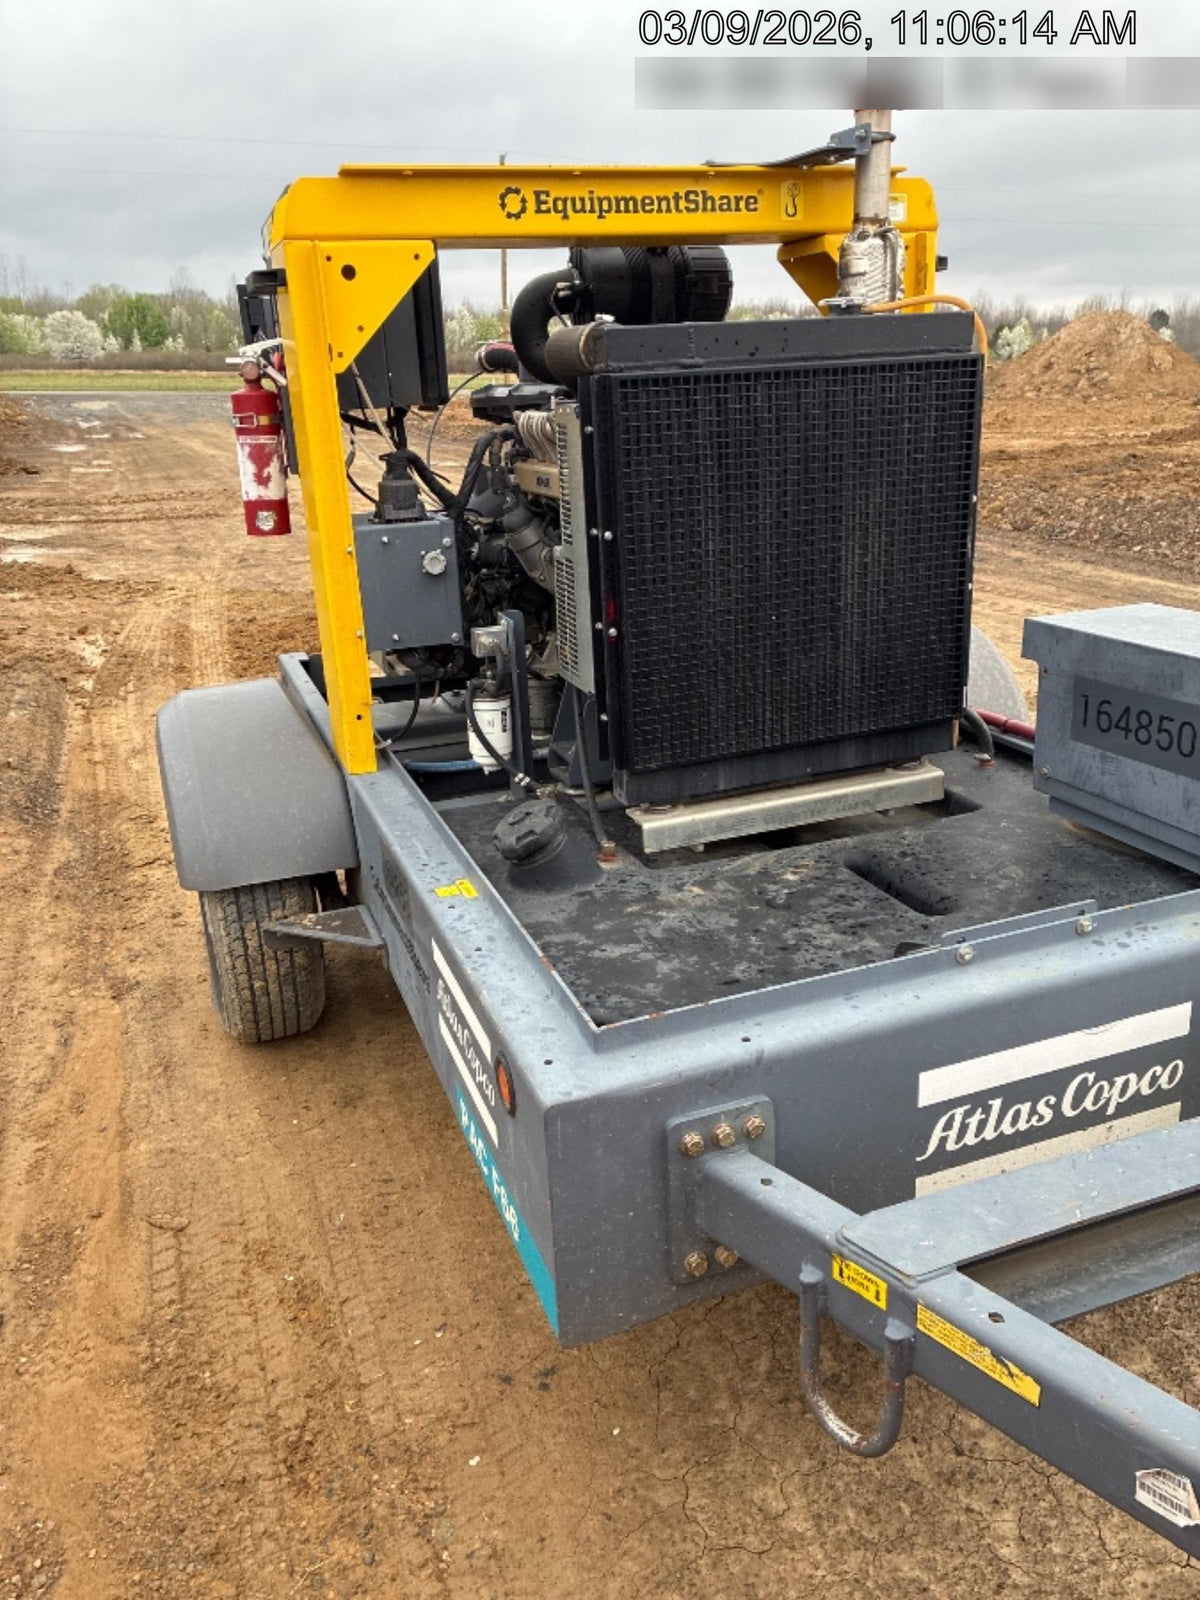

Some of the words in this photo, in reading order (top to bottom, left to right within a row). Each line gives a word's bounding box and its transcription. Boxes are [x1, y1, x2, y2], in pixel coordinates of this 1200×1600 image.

[1080, 693, 1198, 758] 164850
[463, 1028, 496, 1107] Copco
[914, 1093, 1056, 1162] Atlas
[1060, 1059, 1184, 1117] Copco
